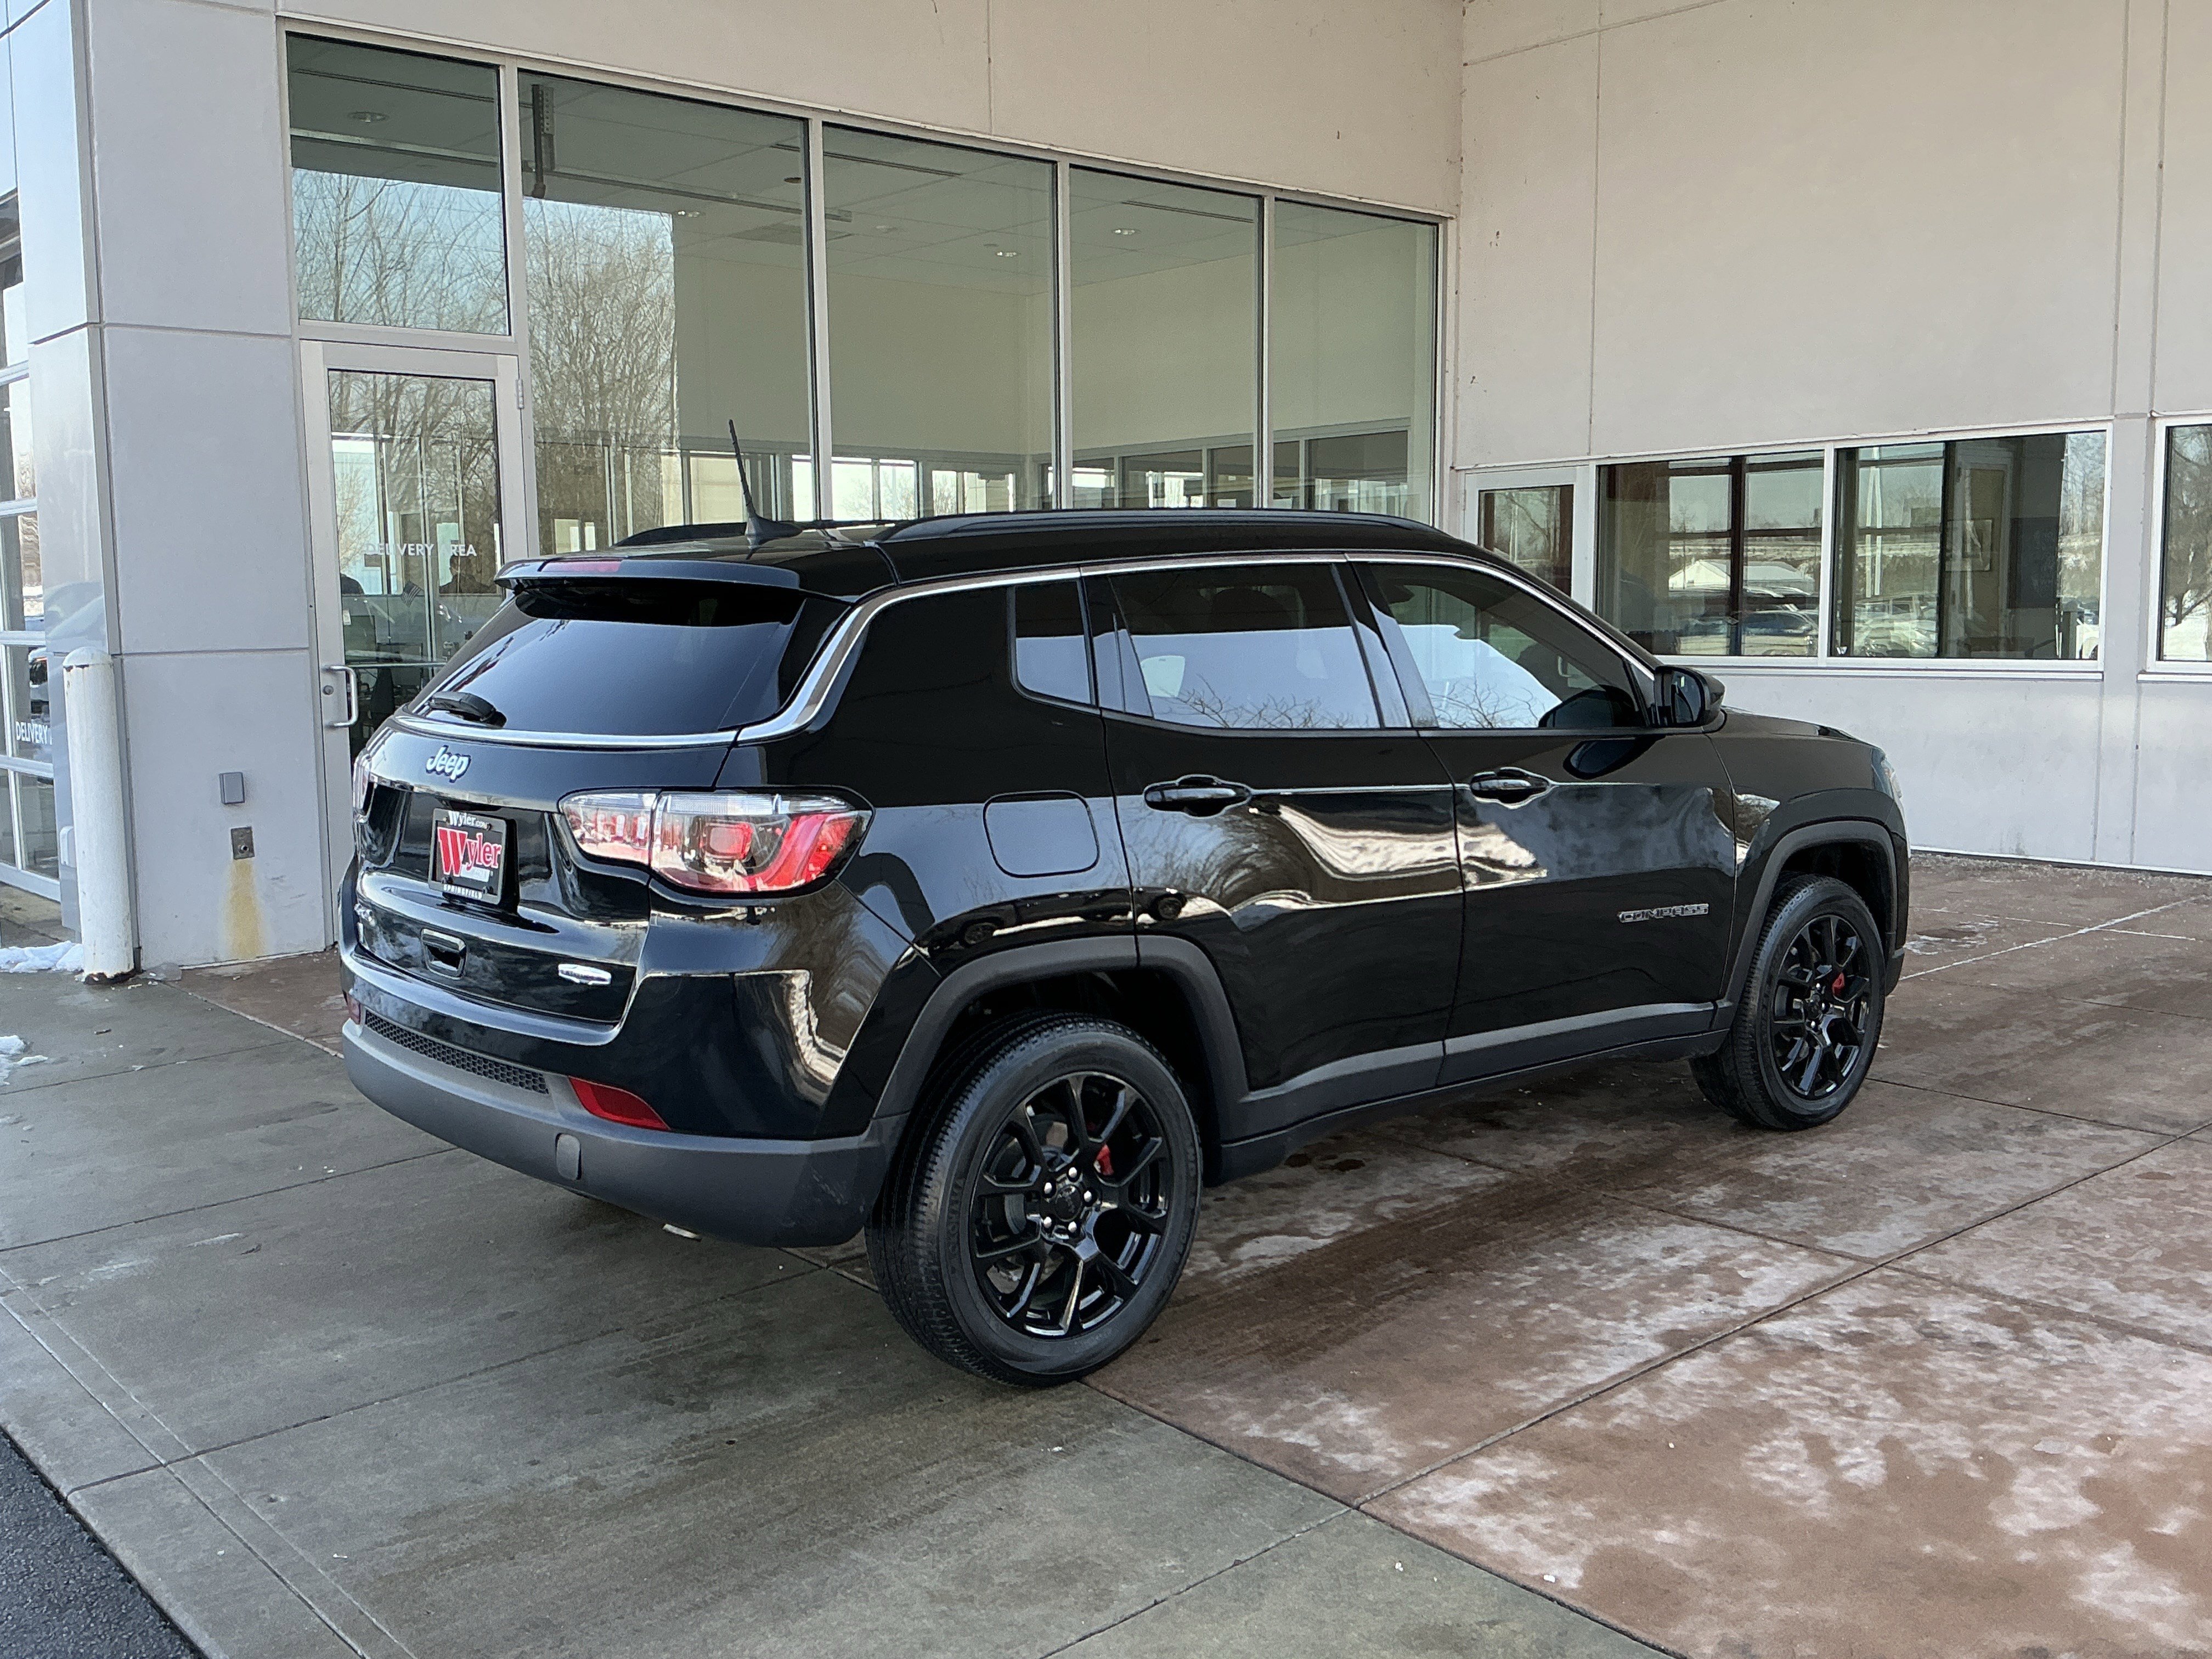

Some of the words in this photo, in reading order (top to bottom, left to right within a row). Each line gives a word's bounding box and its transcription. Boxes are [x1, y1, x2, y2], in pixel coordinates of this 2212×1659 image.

[366, 543, 434, 556] DELVERY
[439, 544, 477, 557] REA
[15, 721, 48, 745] DELIVERY
[426, 745, 471, 783] Jeep
[437, 827, 502, 877] Wyler
[1618, 903, 1709, 923] COMPASS
